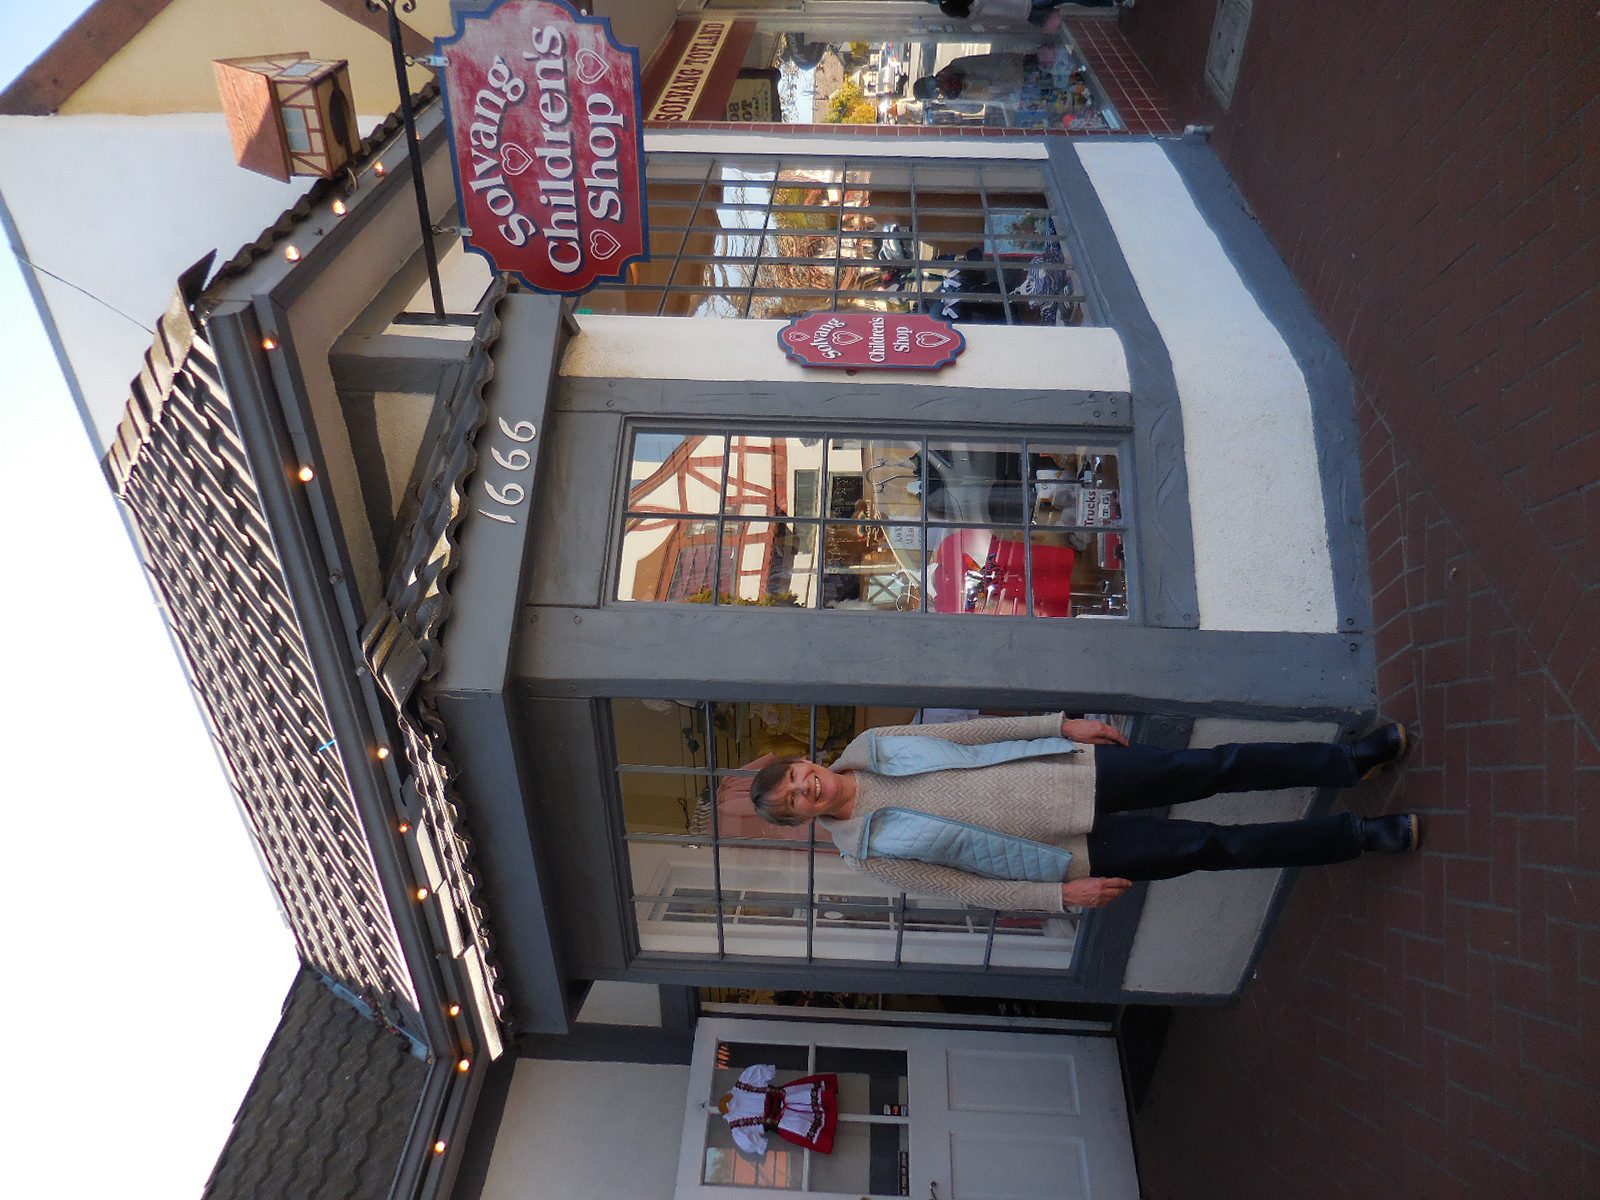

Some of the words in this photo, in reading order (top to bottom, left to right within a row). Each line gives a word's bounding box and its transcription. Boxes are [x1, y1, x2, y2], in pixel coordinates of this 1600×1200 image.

[654, 68, 703, 121] SOLVANG
[684, 22, 725, 66] TOYLAND
[469, 53, 537, 247] Solvang
[524, 25, 582, 274] Children's
[583, 92, 624, 222] Shop
[810, 318, 846, 359] Solvang
[868, 317, 886, 362] Children's
[893, 326, 913, 353] Shop
[478, 416, 537, 524] 1666
[1084, 491, 1097, 527] Trucks
